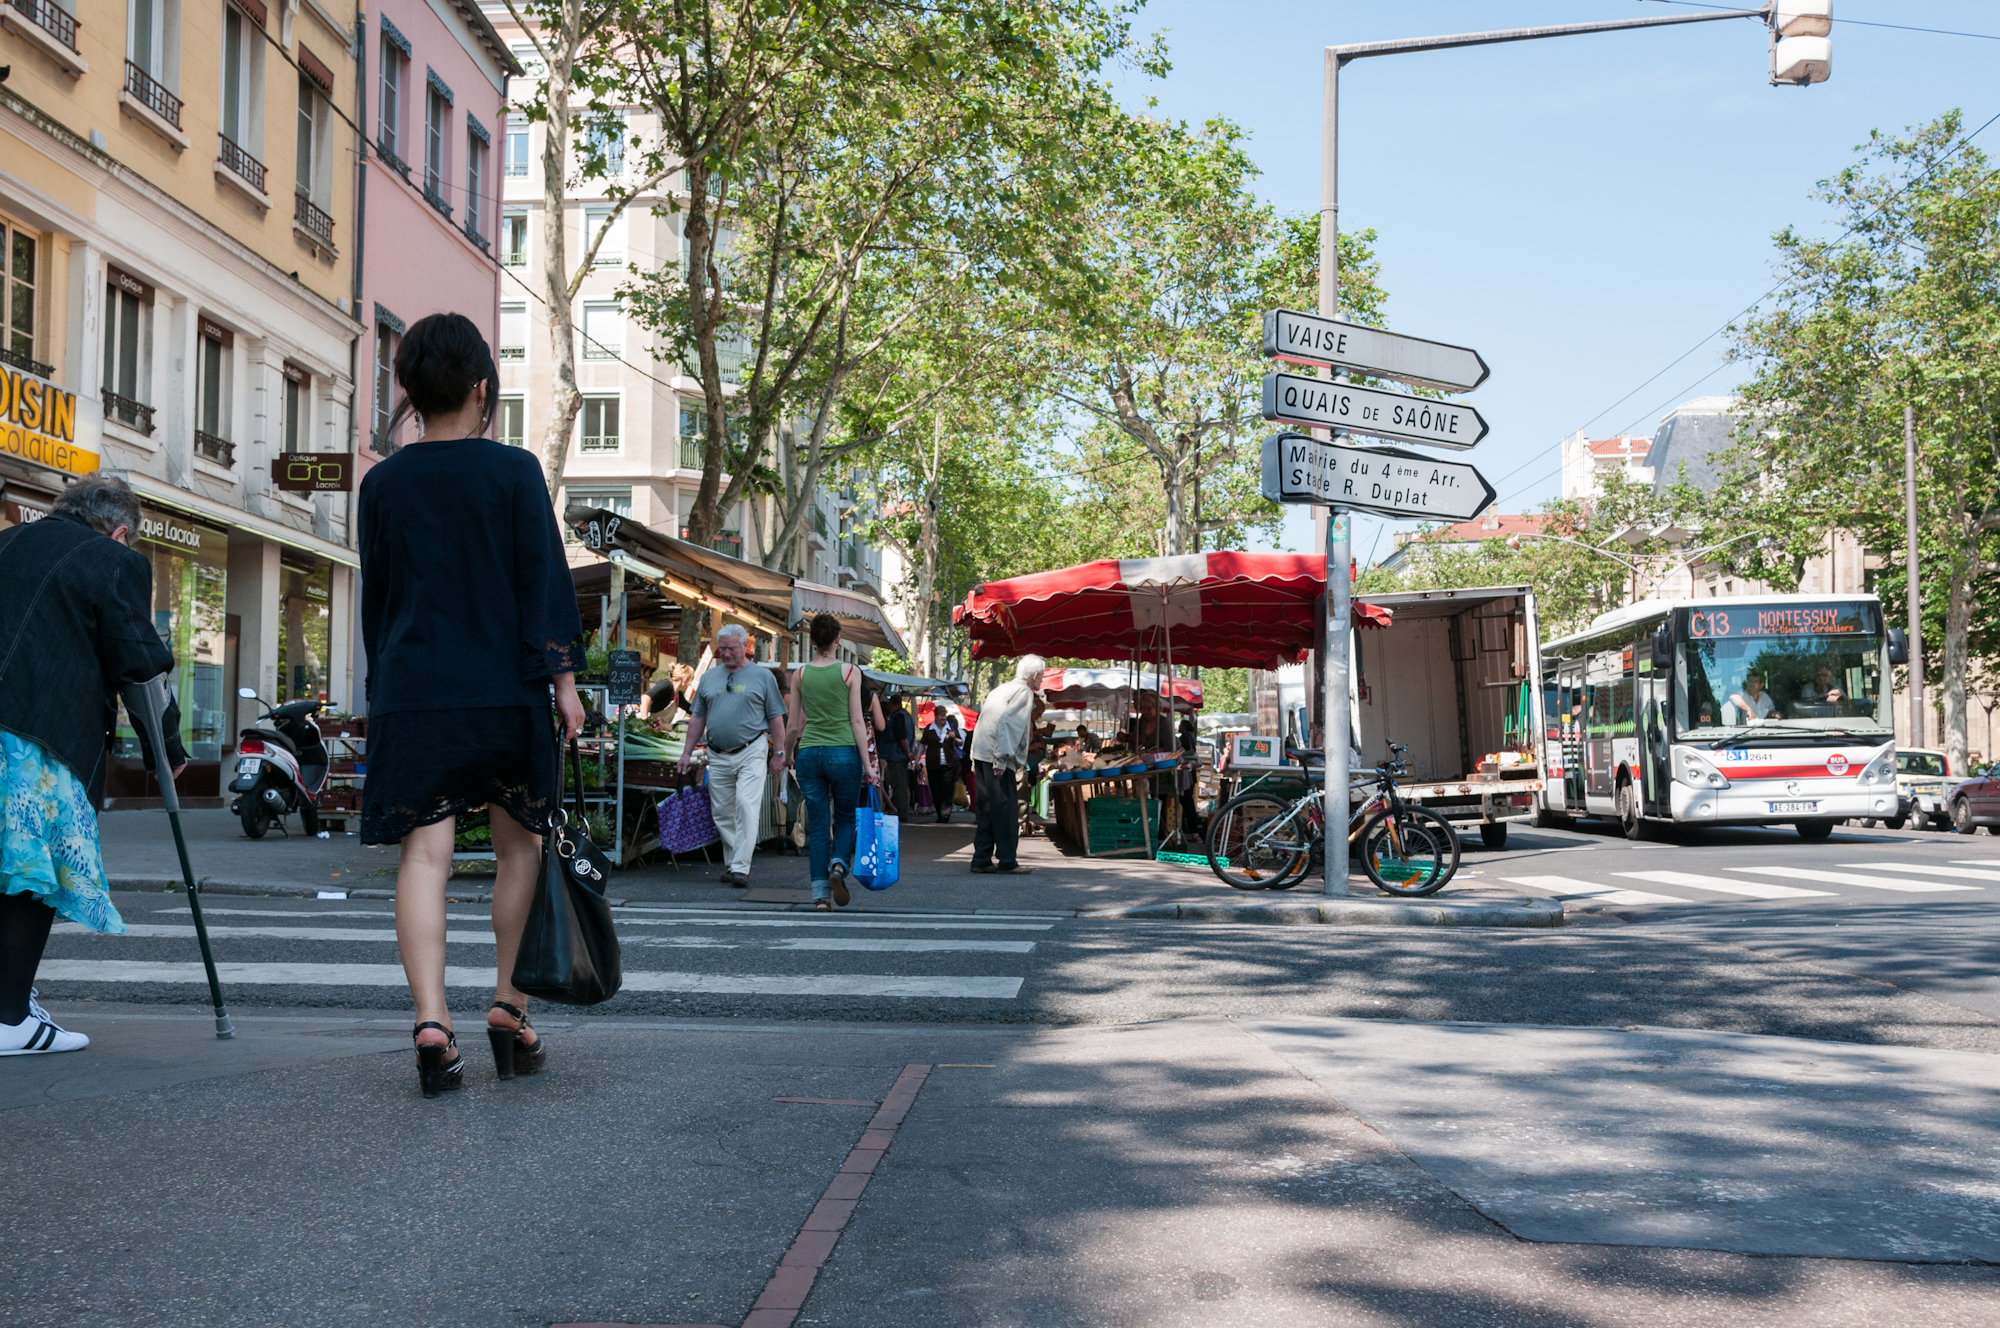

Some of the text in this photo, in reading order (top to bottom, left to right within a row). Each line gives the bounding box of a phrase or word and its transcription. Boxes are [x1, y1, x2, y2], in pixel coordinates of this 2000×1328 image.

[120, 274, 142, 294] Optique
[205, 322, 222, 338] Lacroix
[1288, 324, 1348, 354] VAISE
[1284, 387, 1458, 434] QUAIS DE SAÔNE
[1290, 446, 1336, 470] Mairie
[1351, 458, 1369, 475] du
[1429, 470, 1460, 488] Arr.
[1291, 470, 1330, 492] Stade
[1343, 479, 1358, 496] R.
[1372, 483, 1428, 507] Duplat
[164, 520, 200, 548] Lacroix
[307, 586, 328, 597] Audition
[1691, 609, 1837, 636] C13 MONTESSUY
[1758, 625, 1797, 634] Part-Dieu
[1811, 624, 1854, 632] Cordeliers
[611, 671, 640, 684] 2,30€
[614, 685, 620, 694] le
[622, 685, 634, 697] pot
